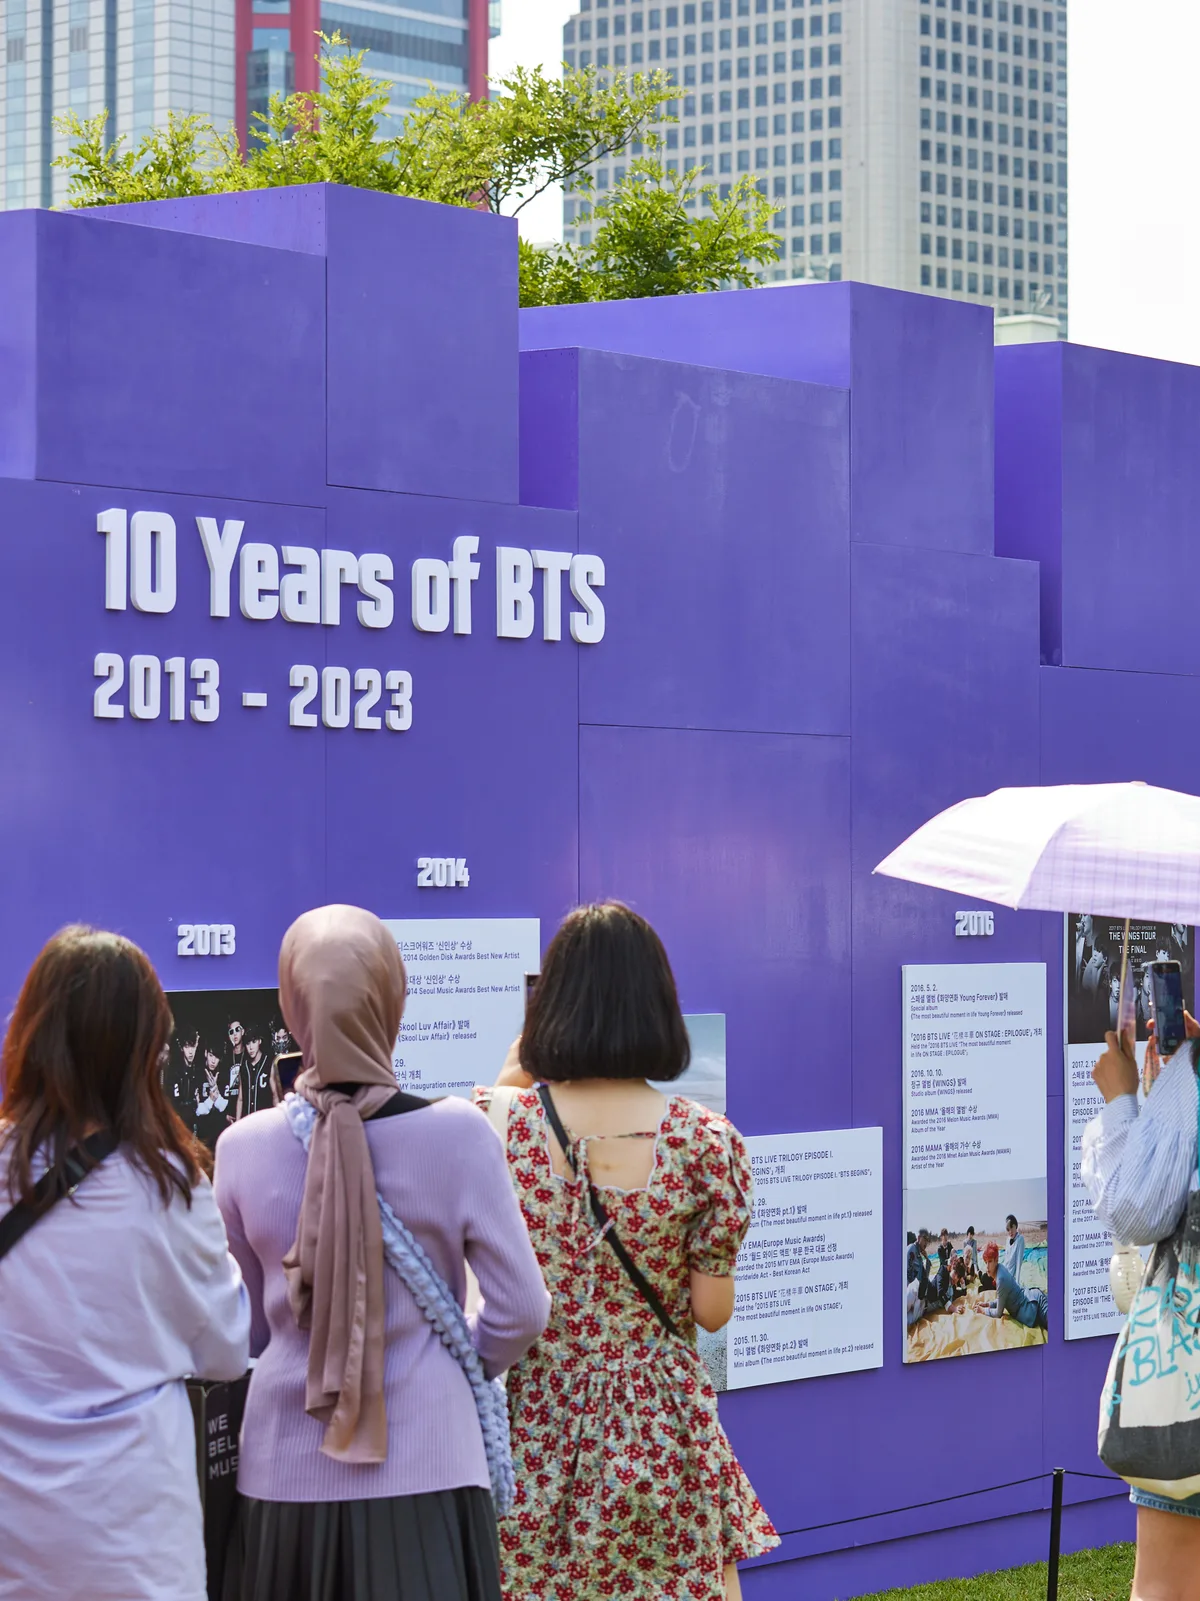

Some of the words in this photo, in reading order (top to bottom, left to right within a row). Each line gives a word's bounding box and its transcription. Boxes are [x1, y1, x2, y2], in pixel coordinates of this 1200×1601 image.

[97, 508, 176, 613] 10
[195, 516, 394, 629] Years
[411, 535, 480, 634] of
[496, 546, 605, 644] BTS
[94, 652, 220, 722] 2013
[242, 692, 267, 707] -
[289, 664, 412, 731] 2023
[417, 857, 470, 887] 2014
[955, 910, 994, 936] 2016
[177, 924, 236, 956] 2013
[1109, 932, 1120, 940] THE
[1122, 932, 1140, 940] WNGS
[1141, 932, 1156, 940] TOUR
[460, 940, 472, 950] 수상
[1119, 946, 1129, 954] TE
[1131, 946, 1147, 954] FINAL
[419, 953, 439, 961] Golden
[448, 974, 460, 984] 수상
[419, 987, 435, 995] Seoul
[455, 986, 476, 994] Awards
[911, 984, 925, 992] 2016.
[960, 994, 975, 1002] Young
[419, 1022, 431, 1030] Luv
[453, 1032, 477, 1040] released
[927, 1032, 938, 1040] BTS
[939, 1032, 950, 1040] LIVE
[975, 1030, 983, 1038] ON
[984, 1029, 1000, 1038] STAGE
[395, 1059, 406, 1067] 29.
[409, 1070, 421, 1080] 개최
[911, 1070, 925, 1078] 2016.
[410, 1081, 446, 1091] inauguration
[448, 1080, 475, 1089] ceremony
[911, 1109, 924, 1117] 2016
[925, 1108, 938, 1116] MMA
[911, 1145, 924, 1153] 2016
[925, 1144, 942, 1152] MAMA
[752, 1156, 763, 1165] BTS
[765, 1154, 777, 1164] LIVE
[779, 1153, 803, 1162] TRILOGY
[805, 1151, 828, 1160] EPISODE
[752, 1167, 773, 1176] EGINS'」
[770, 1176, 780, 1184] BTS
[780, 1175, 791, 1183] LIVE
[792, 1174, 812, 1182] TRILOGY
[814, 1172, 833, 1180] EPISODE
[785, 1237, 801, 1246] Music
[803, 1234, 825, 1244] Awards)
[752, 1291, 763, 1300] BTS
[764, 1290, 777, 1299] LIVE
[804, 1286, 813, 1294] ON
[1087, 1286, 1097, 1294] BTS
[1098, 1284, 1108, 1293] LIVE
[734, 1336, 749, 1345] 2015.
[760, 1333, 769, 1342] 30.
[745, 1359, 760, 1367] album
[773, 1355, 785, 1363] most
[786, 1352, 807, 1362] beautiful
[808, 1350, 827, 1358] moment
[833, 1347, 841, 1355] life
[854, 1343, 874, 1351] released
[208, 1413, 228, 1435] WE
